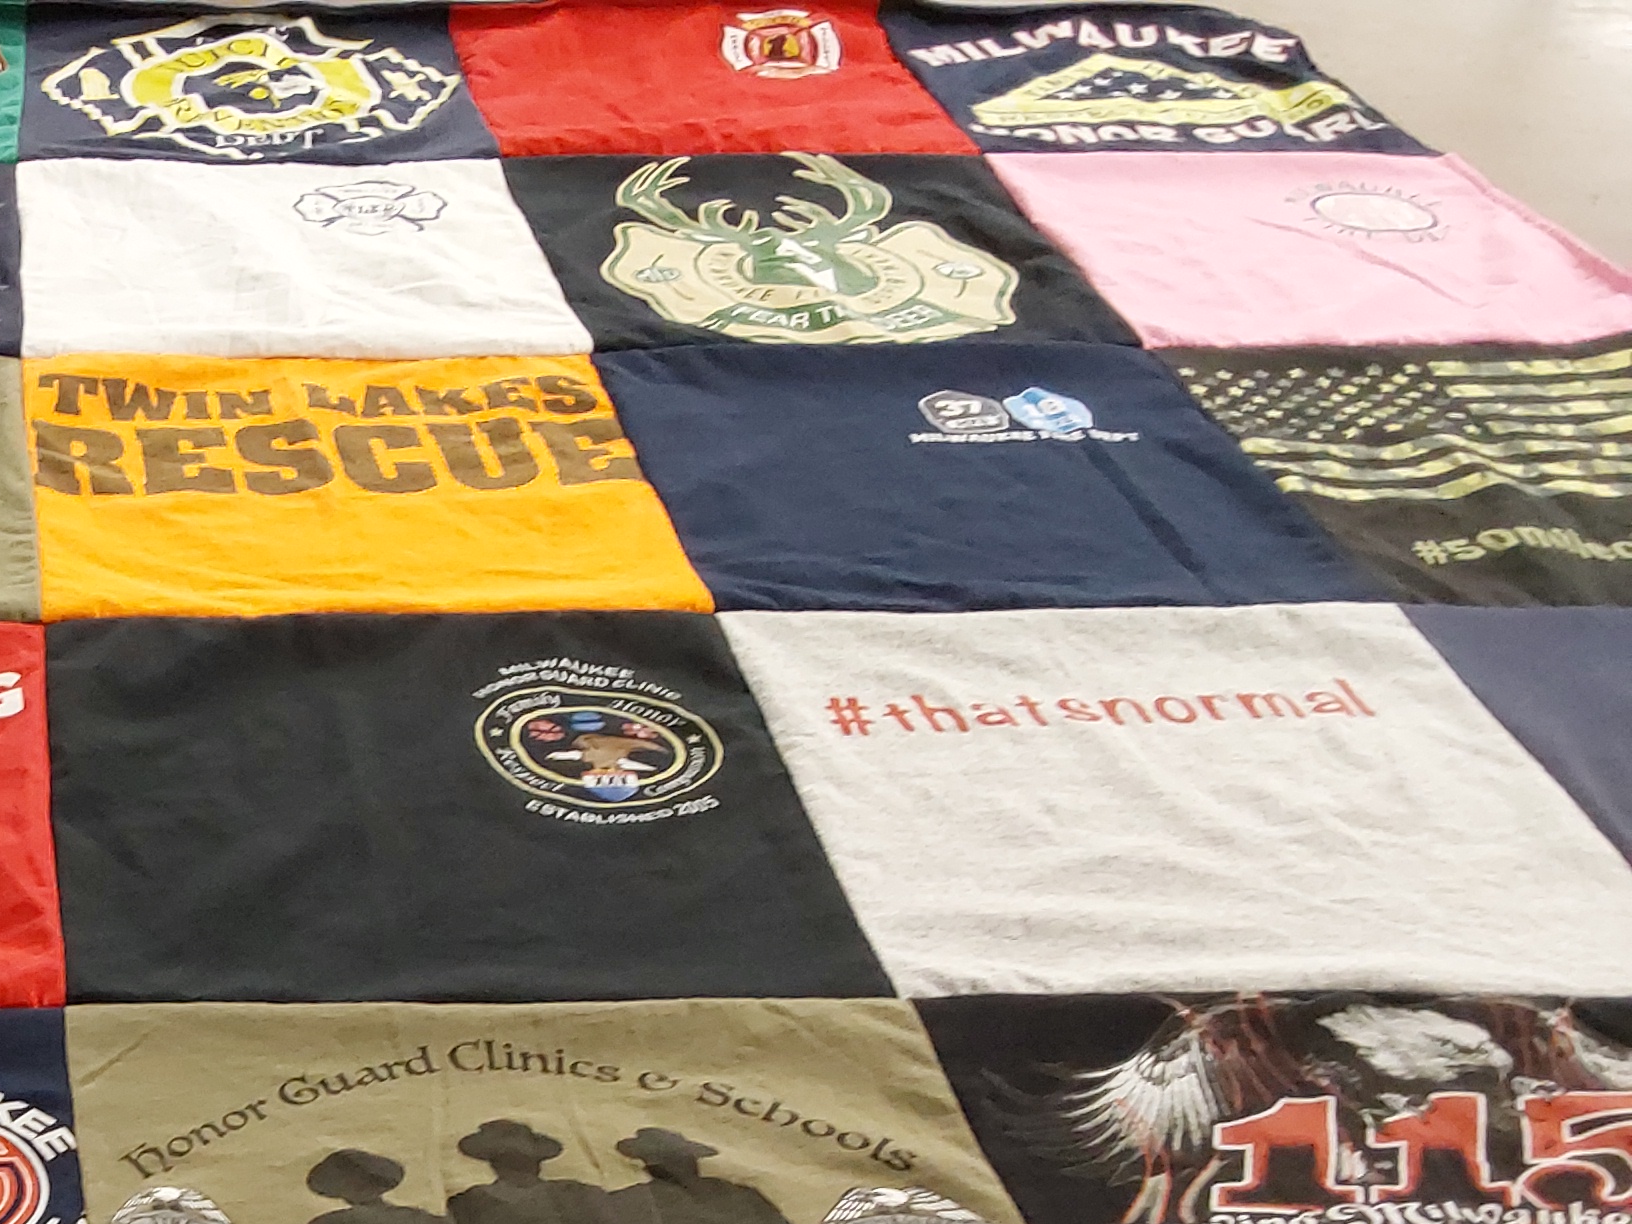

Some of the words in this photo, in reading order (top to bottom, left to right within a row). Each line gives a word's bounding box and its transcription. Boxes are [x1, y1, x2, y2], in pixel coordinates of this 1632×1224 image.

[906, 19, 1298, 67] MILWAUKEE
[38, 373, 273, 421] TWIN
[301, 375, 598, 418] LAKES
[32, 418, 644, 496] RESCUE
[498, 657, 636, 680] MILWAUKEE
[538, 669, 609, 689] GUARD
[822, 677, 1378, 737] #thatsnormal
[524, 799, 672, 824] ESTABLISHED
[278, 1045, 442, 1106] Guard
[447, 1039, 621, 1084] Clinics
[695, 1080, 919, 1172] Schools
